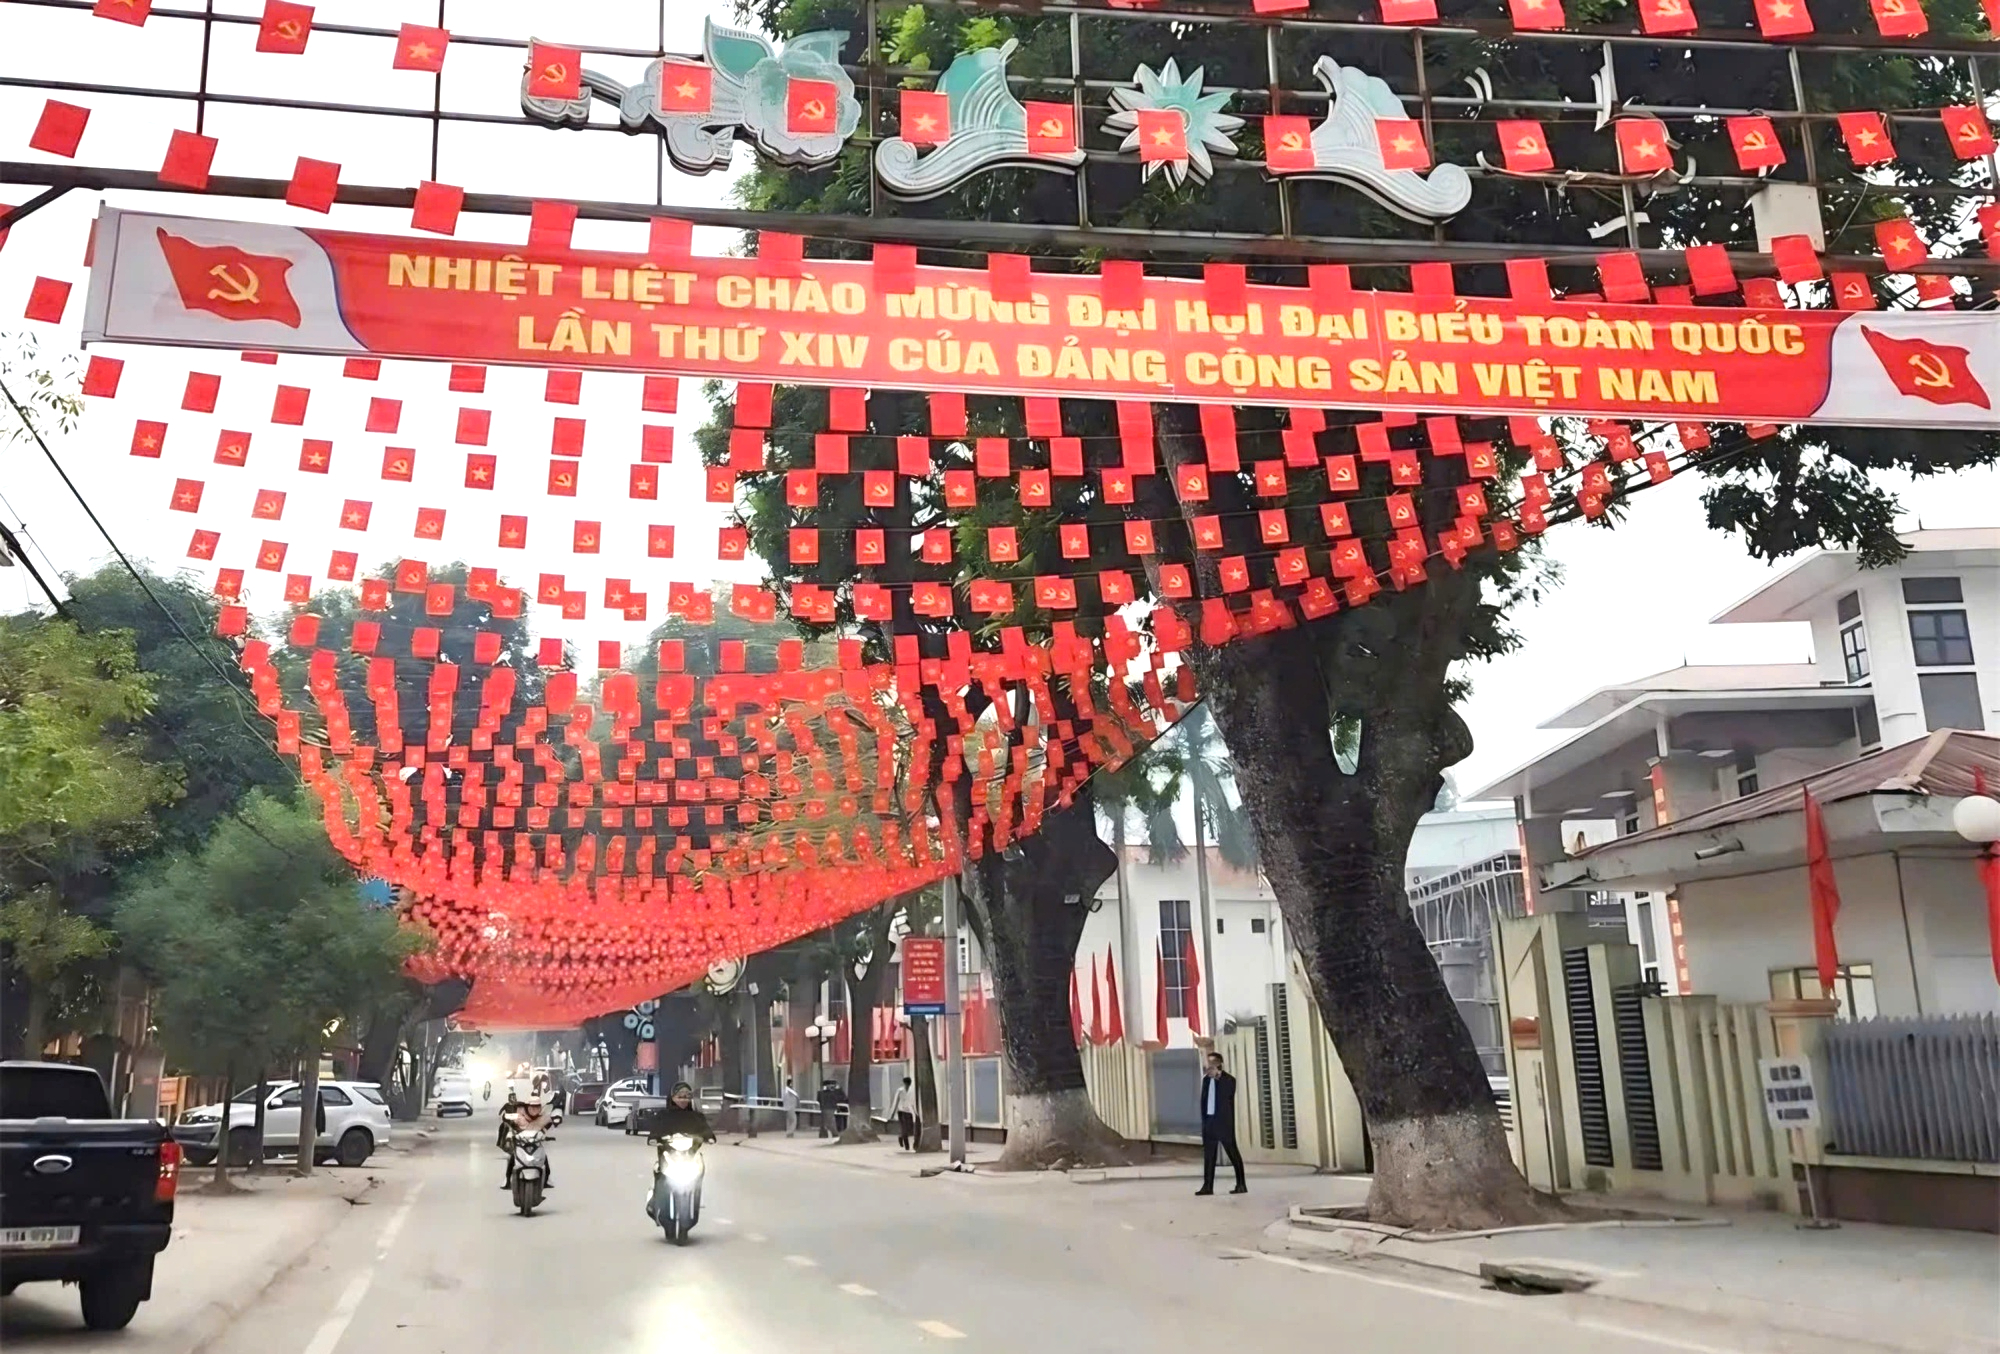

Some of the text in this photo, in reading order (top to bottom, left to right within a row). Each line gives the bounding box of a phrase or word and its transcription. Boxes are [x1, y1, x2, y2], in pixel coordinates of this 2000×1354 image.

[388, 253, 562, 300] NHIỆT
[581, 263, 697, 310] LIỆT
[717, 272, 865, 315] CHÀO
[1279, 304, 1368, 345] ĐẠI
[1521, 311, 1654, 351] TOÀN
[1670, 312, 1805, 356] QUỐC
[518, 306, 1719, 405] LẦN THỨ XIV CỦA ĐẢNG CỘNG SẢN VIỆT NAM
